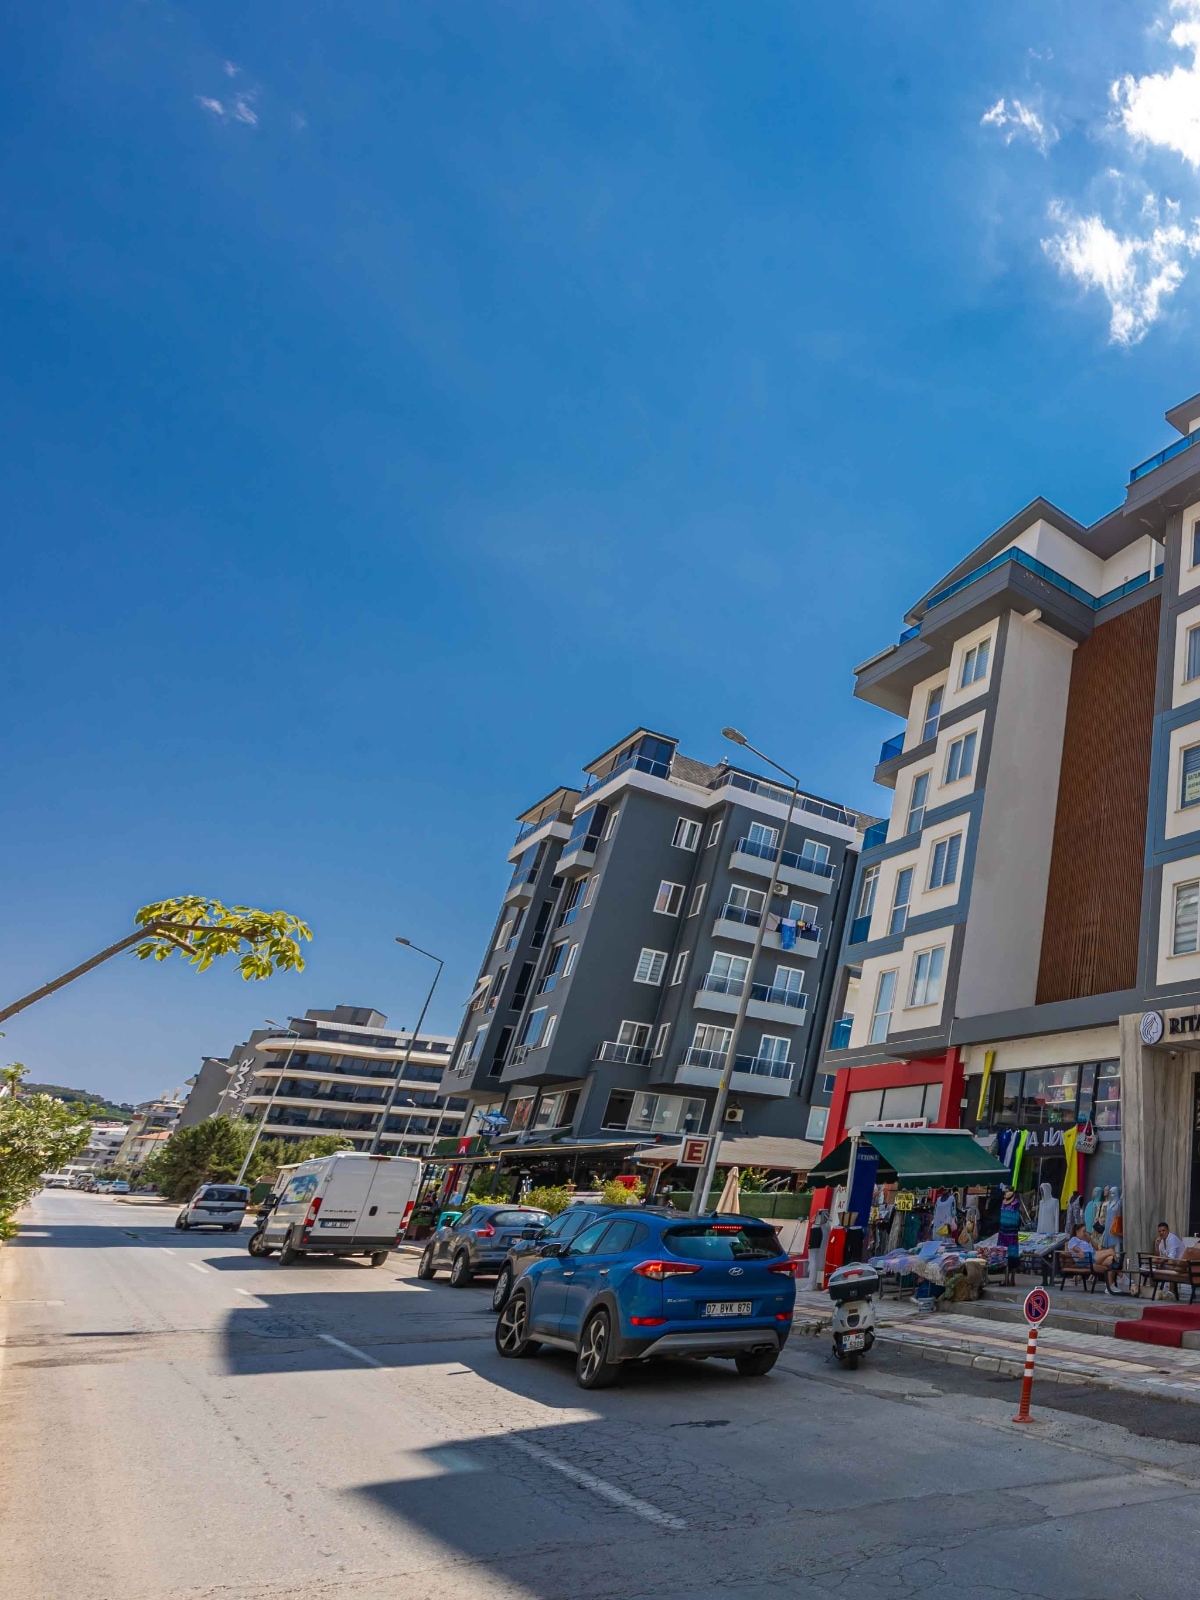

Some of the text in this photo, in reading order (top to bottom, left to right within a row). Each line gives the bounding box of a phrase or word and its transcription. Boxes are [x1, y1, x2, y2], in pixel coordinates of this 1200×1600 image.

[689, 1141, 704, 1161] E
[707, 1304, 716, 1314] 07
[738, 1303, 751, 1312] 876
